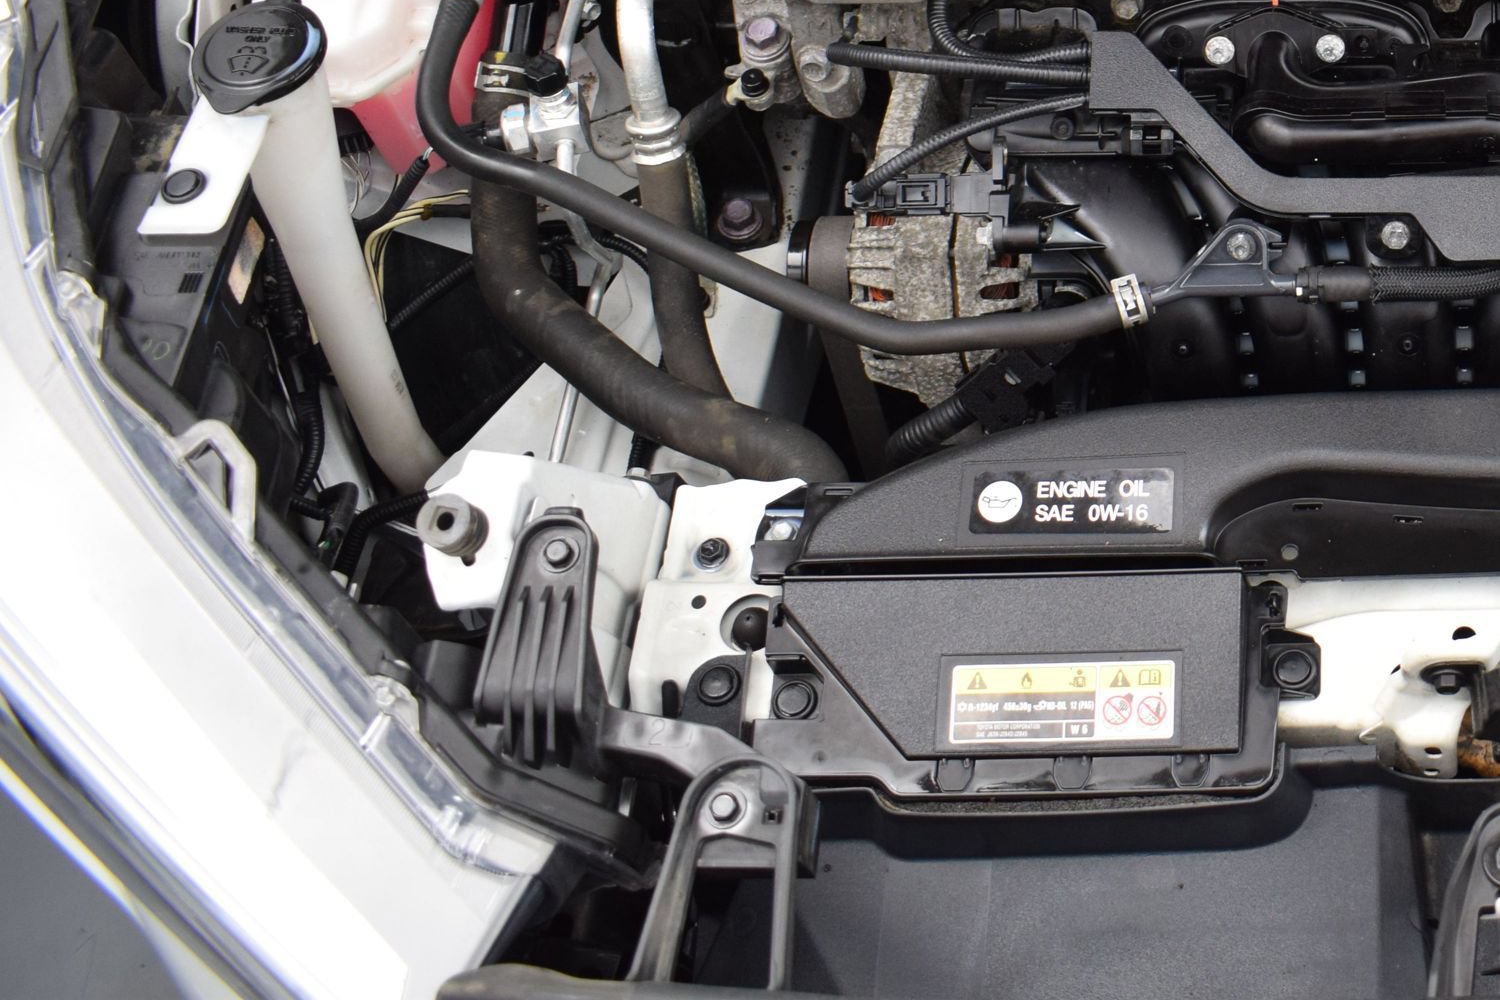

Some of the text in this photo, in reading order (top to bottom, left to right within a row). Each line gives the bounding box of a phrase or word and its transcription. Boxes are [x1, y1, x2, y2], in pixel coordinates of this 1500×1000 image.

[1036, 479, 1151, 499] ENGINE OIL
[1034, 504, 1149, 522] SAE 0W-16
[1071, 723, 1081, 735] W
